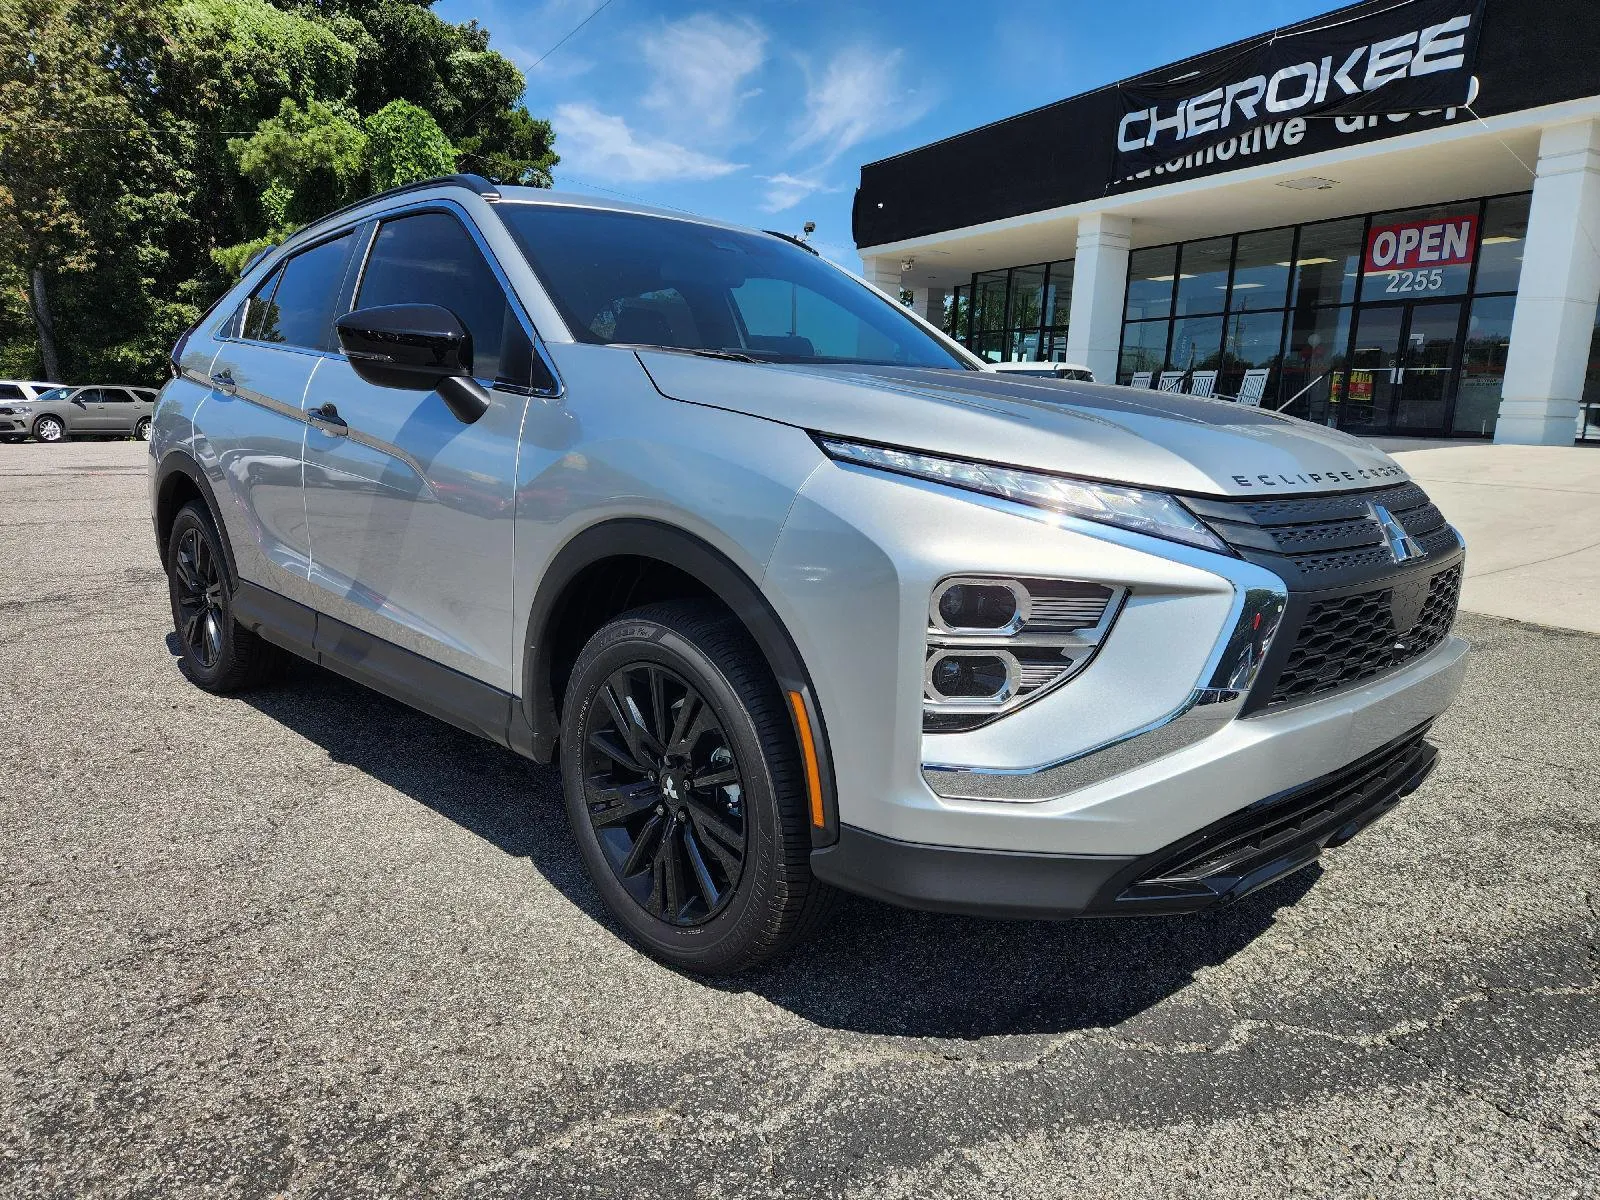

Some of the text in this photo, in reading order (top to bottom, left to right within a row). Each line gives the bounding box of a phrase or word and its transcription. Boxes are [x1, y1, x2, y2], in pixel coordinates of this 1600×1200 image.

[1117, 14, 1471, 153] CHEROKEE
[1372, 221, 1471, 267] OPEN
[1385, 269, 1443, 293] 2255
[1231, 471, 1355, 487] ECLIPSE
